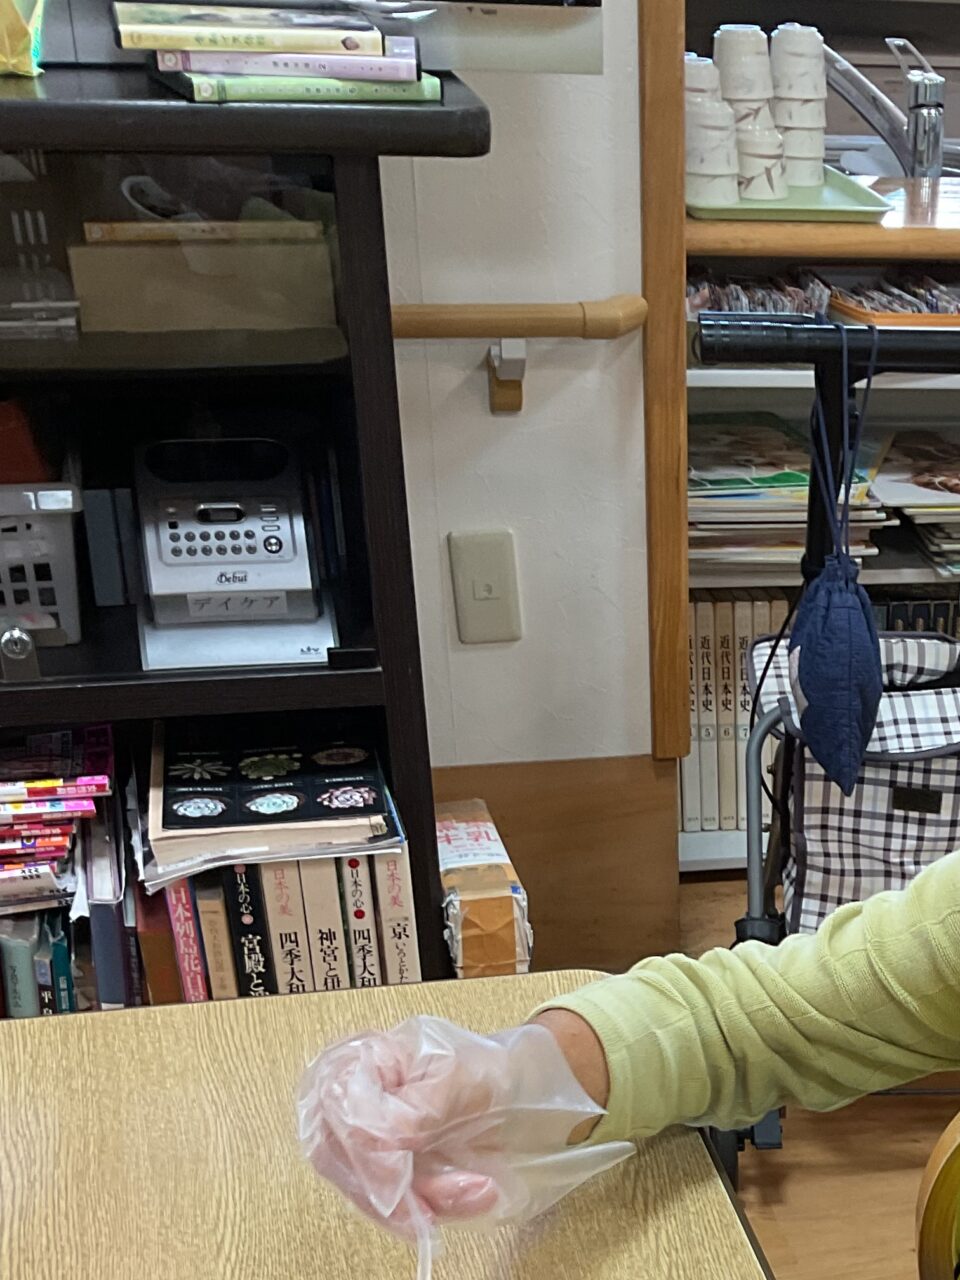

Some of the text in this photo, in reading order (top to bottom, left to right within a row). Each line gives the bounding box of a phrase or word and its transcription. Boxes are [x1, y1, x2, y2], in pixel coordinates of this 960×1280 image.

[216, 571, 248, 585] Debut
[193, 597, 281, 612] デイケア
[700, 635, 713, 713] 近代日本史
[720, 635, 732, 713] 近代日本史
[704, 728, 711, 738] 5
[723, 728, 731, 737] 6
[742, 728, 749, 737] 7
[235, 872, 253, 914] 日本の心
[350, 868, 365, 909] 日本の心
[240, 934, 270, 996] 宮殿と
